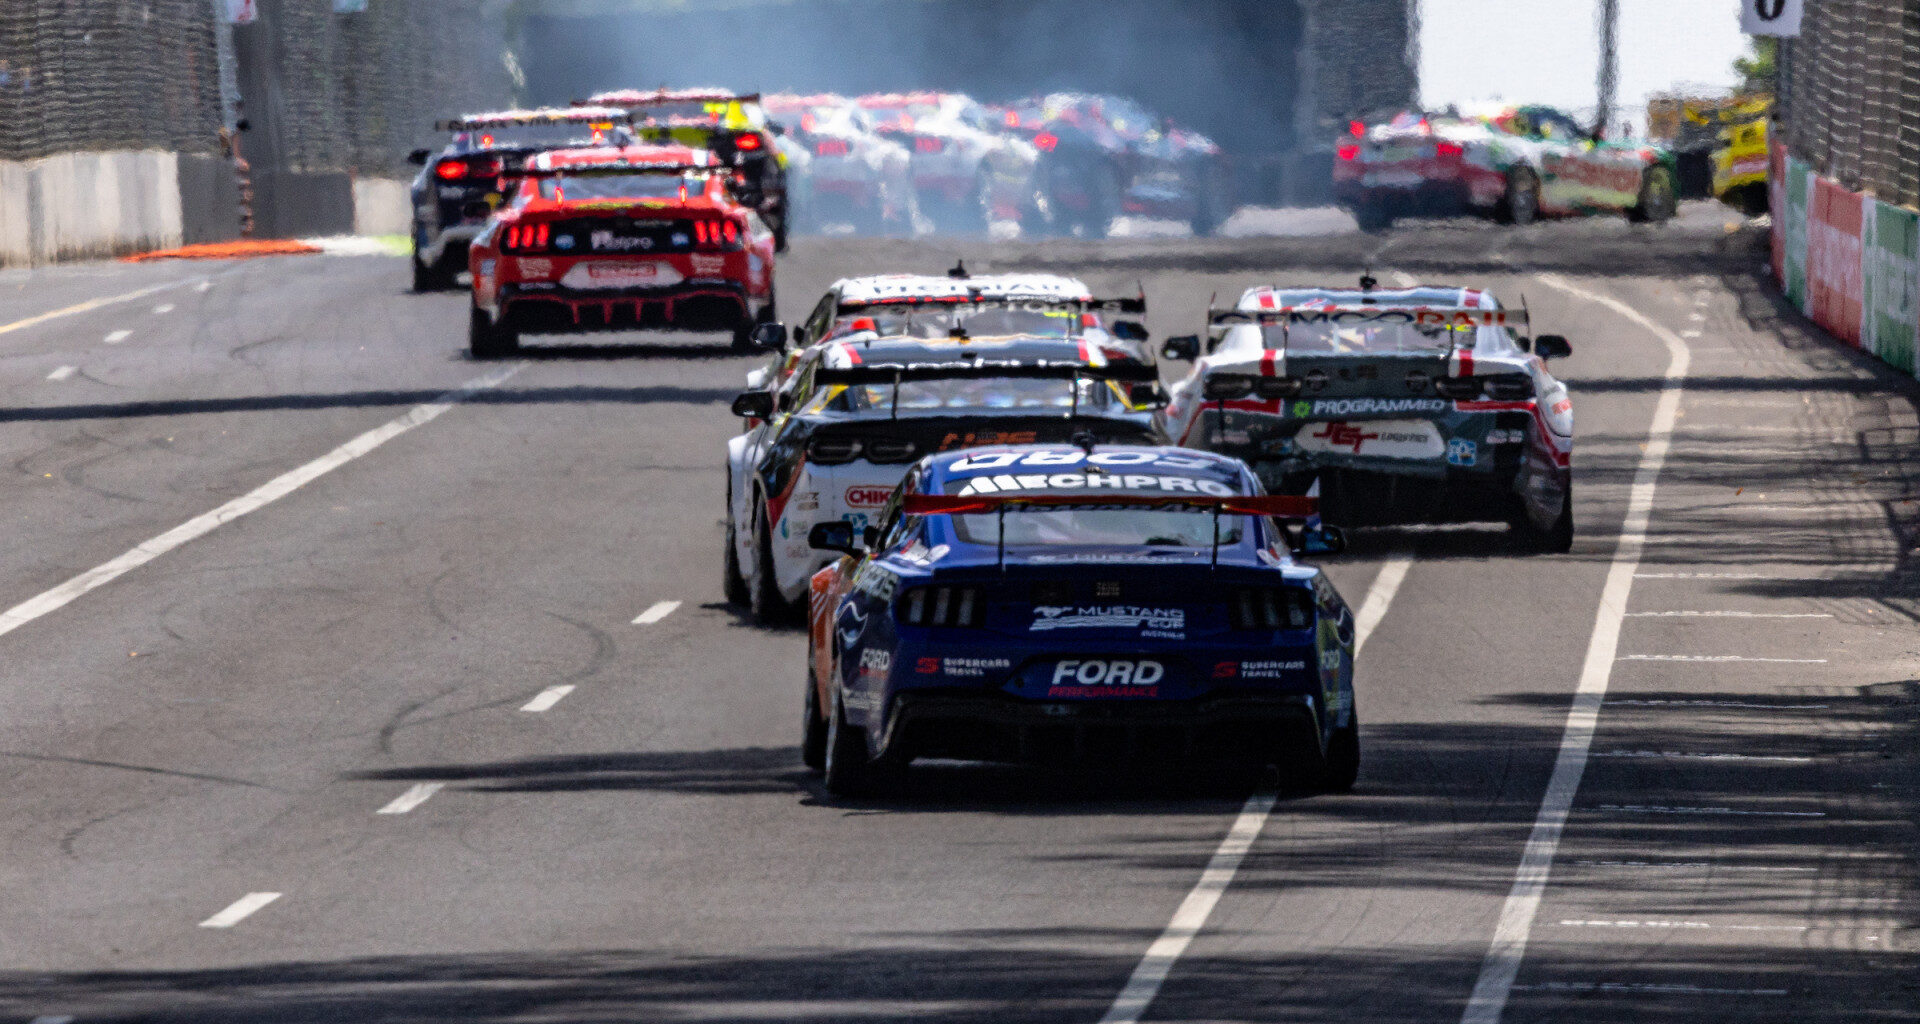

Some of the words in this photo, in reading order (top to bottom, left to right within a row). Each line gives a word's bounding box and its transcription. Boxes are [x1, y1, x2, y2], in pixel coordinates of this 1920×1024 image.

[1313, 398, 1445, 415] PROGRAMMED
[848, 488, 893, 505] CHIK
[1077, 605, 1185, 618] MUSTANG
[860, 648, 890, 671] FORD
[943, 656, 1010, 669] SUPERCARS
[1241, 660, 1306, 670] SUPERCARS
[943, 667, 984, 677] TRAVEL
[1051, 659, 1165, 686] FORD
[1240, 669, 1282, 679] TRAVEL
[1047, 686, 1160, 698] PERFORMANCE
